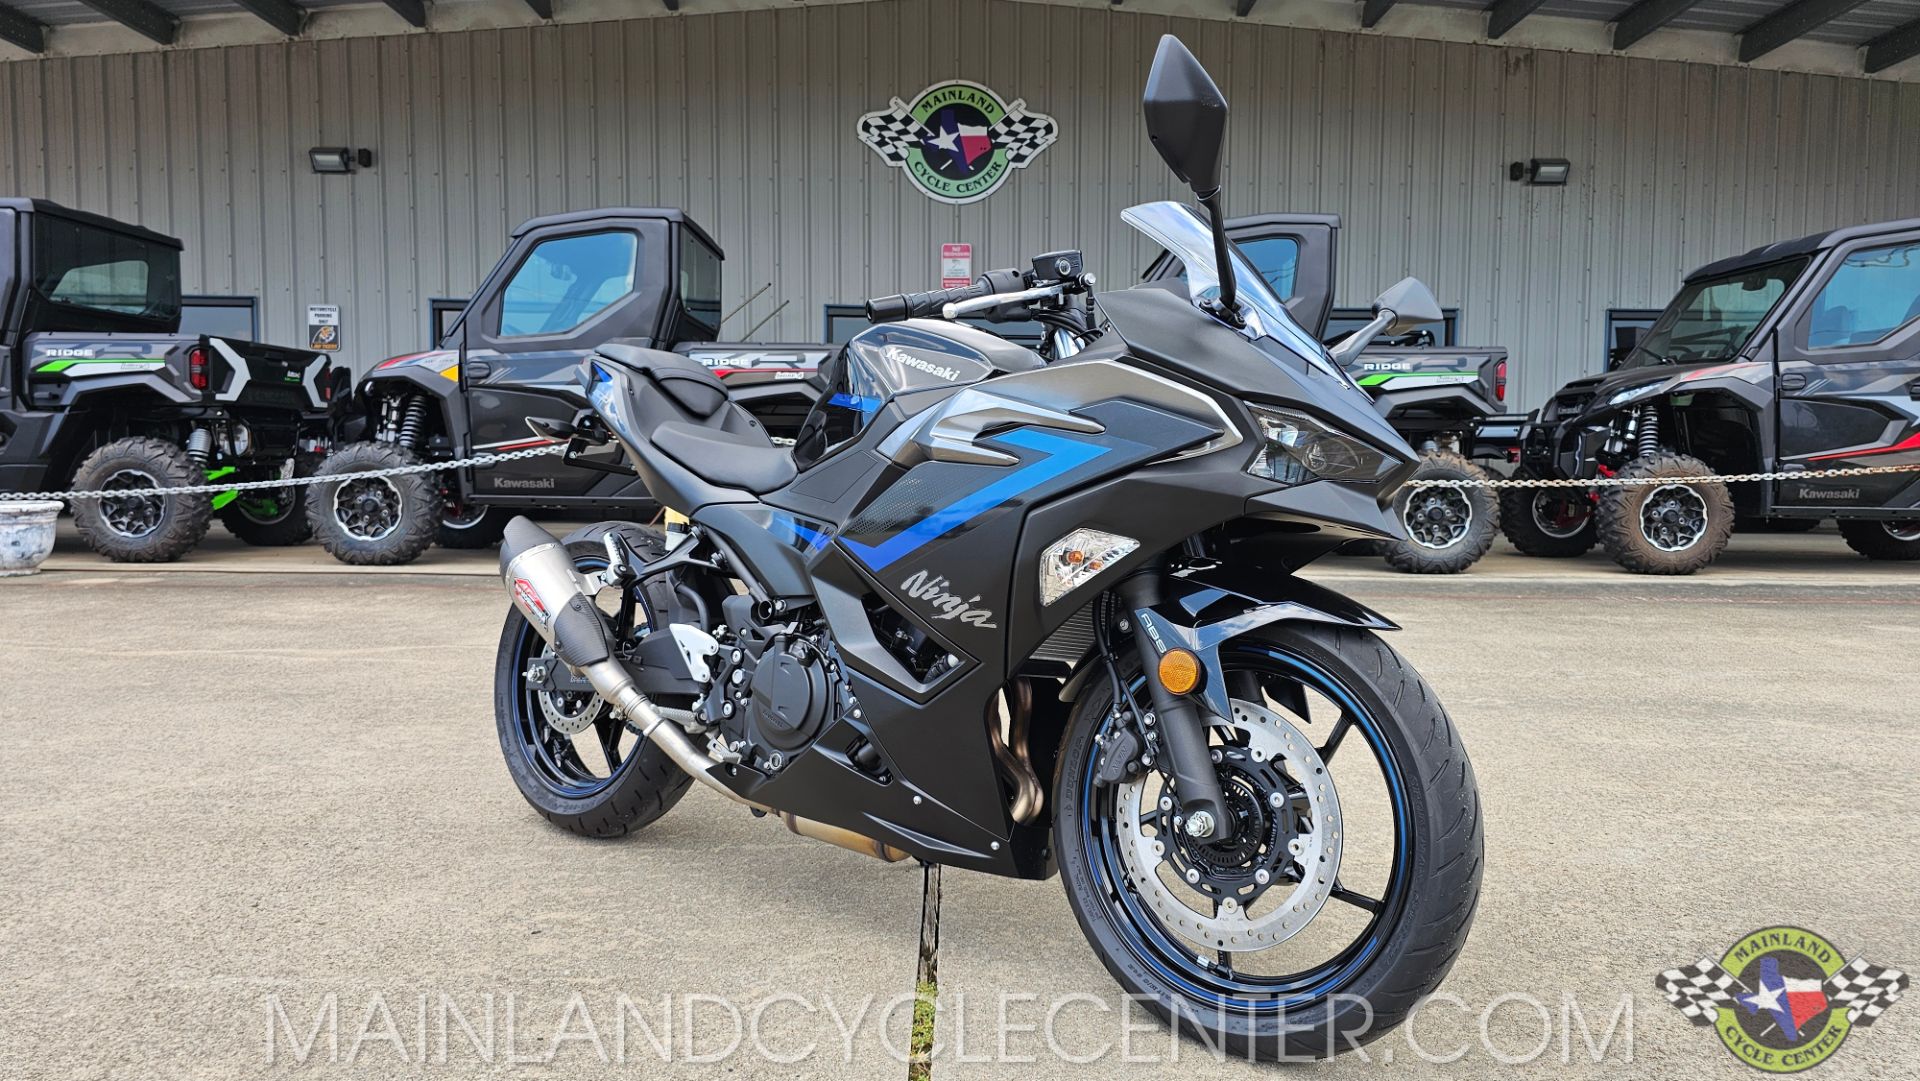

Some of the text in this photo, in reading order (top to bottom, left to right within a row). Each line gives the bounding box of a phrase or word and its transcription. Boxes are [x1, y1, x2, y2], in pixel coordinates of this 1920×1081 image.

[921, 90, 995, 115] MAINLAND
[914, 161, 1003, 193] CYCLE CENTER
[46, 348, 93, 357] RIDGE
[702, 358, 748, 367] RIDGE
[885, 347, 961, 382] Kawasaki
[1364, 362, 1411, 371] RIDGE
[494, 477, 555, 489] Kawasaki
[1799, 488, 1861, 499] Kawasaki
[900, 569, 998, 629] Ninja
[1141, 613, 1167, 654] ABS
